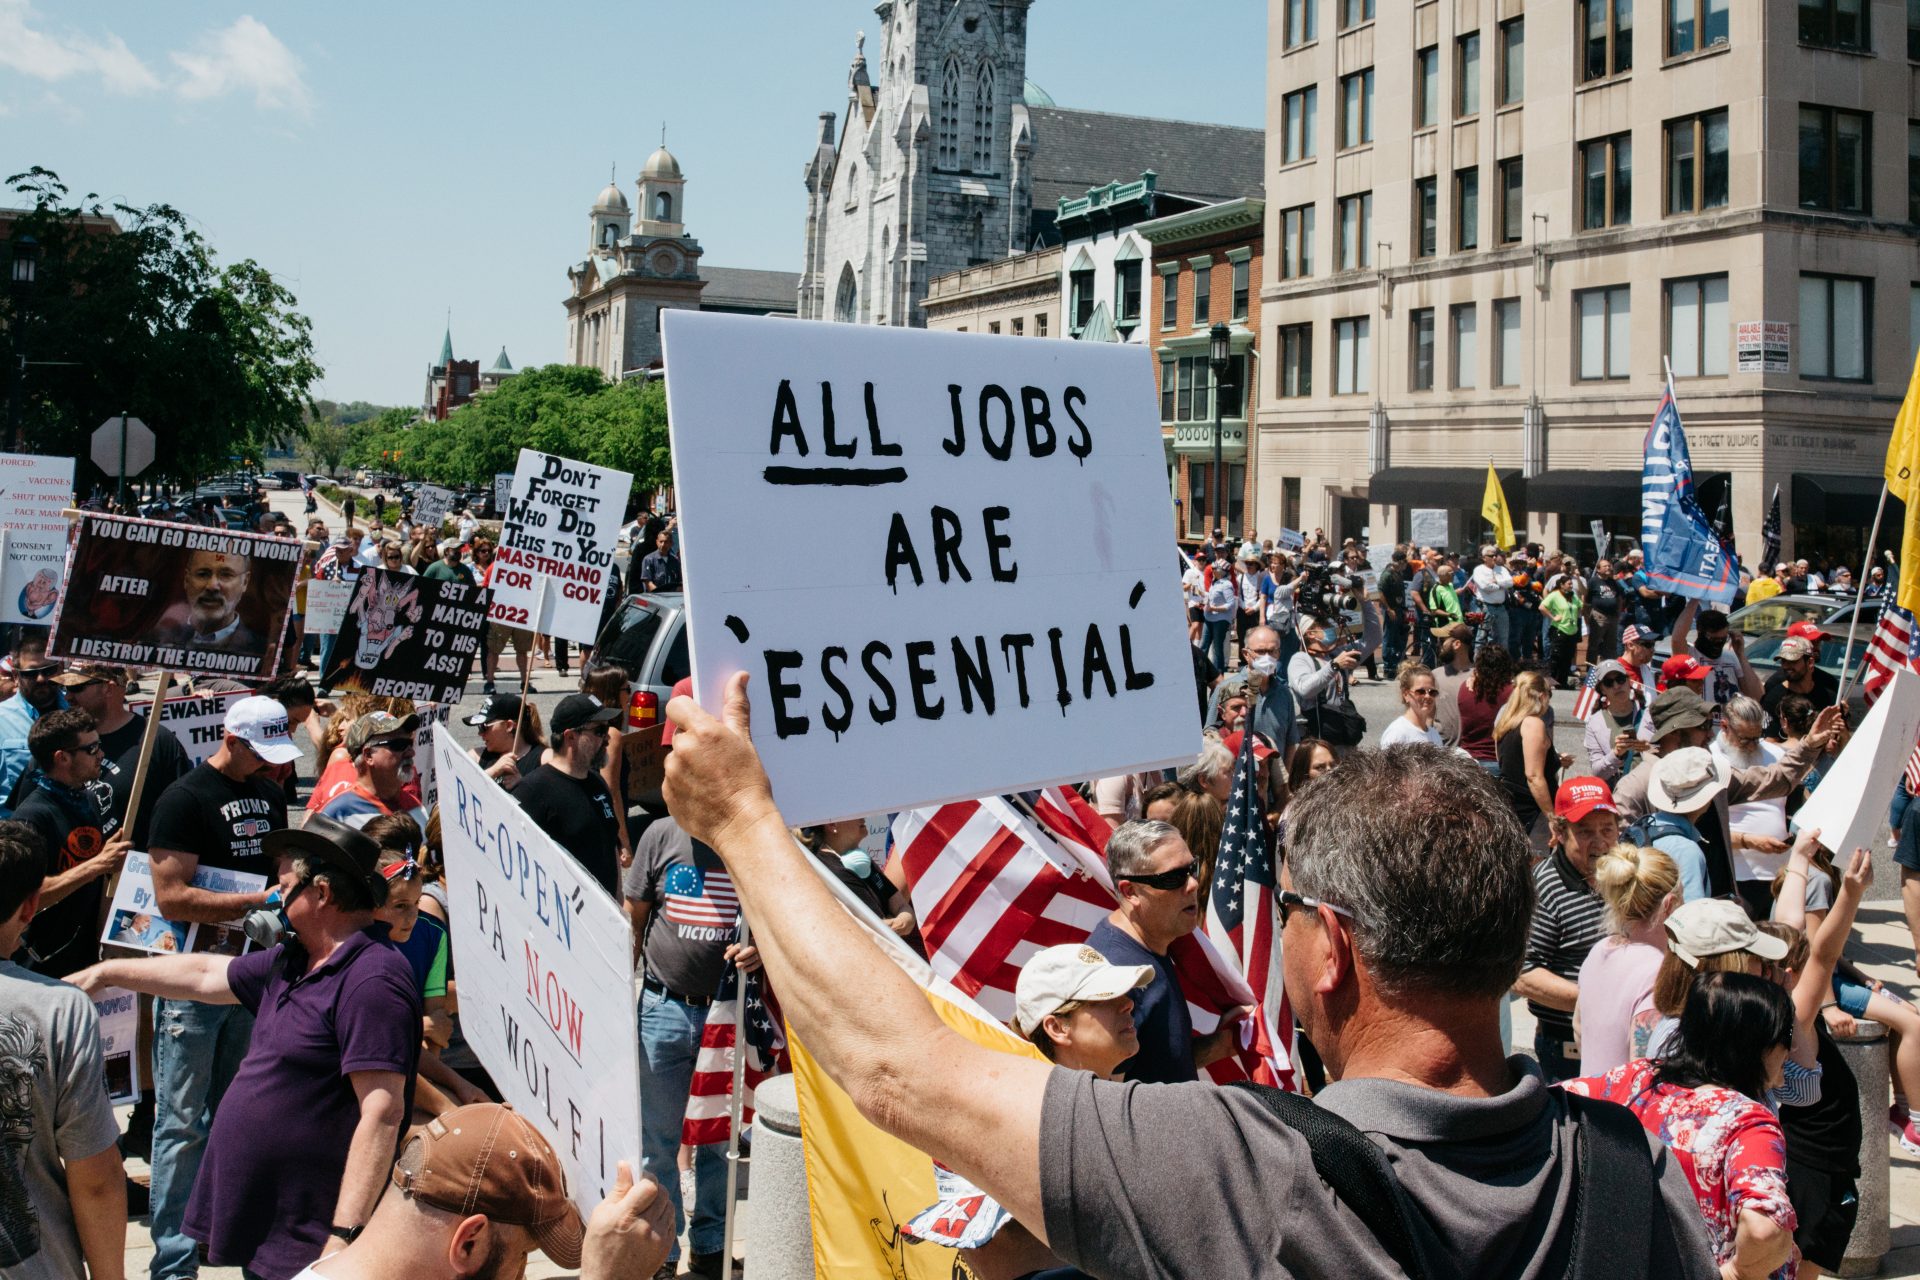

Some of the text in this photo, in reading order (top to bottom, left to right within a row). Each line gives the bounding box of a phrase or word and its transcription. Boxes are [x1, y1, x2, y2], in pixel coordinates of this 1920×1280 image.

[769, 379, 1093, 466] ALL JOBS
[38, 494, 70, 502] DOWNS
[526, 476, 601, 513] FORGET
[508, 497, 548, 528] WHO
[557, 508, 596, 537] DID
[11, 541, 52, 551] CONSENT
[91, 519, 300, 562] YOU CAN GO BACK TO WORK
[504, 522, 545, 553] THIS
[552, 541, 572, 559] TO
[885, 504, 1018, 595] ARE
[9, 553, 66, 563] NOT COMPLY
[496, 547, 602, 585] MASTRIANO
[99, 574, 149, 596] AFTER
[440, 581, 487, 606] SET A
[495, 568, 532, 590] FOR
[562, 583, 601, 605] GOV.
[431, 604, 484, 629] MATCH
[487, 602, 529, 625] 2022
[424, 628, 477, 653] TO HIS
[70, 637, 260, 673] I DESTROY THE ECONOMY
[424, 651, 464, 677] ASS!
[371, 677, 462, 704] REOPEN PA
[189, 724, 225, 745] THE
[1569, 784, 1604, 795] Trump
[220, 799, 270, 822] TRUMP
[235, 821, 268, 834] 20 20
[133, 888, 151, 909] By
[677, 924, 733, 942] VICTORY.
[475, 880, 584, 1061] PA NOW
